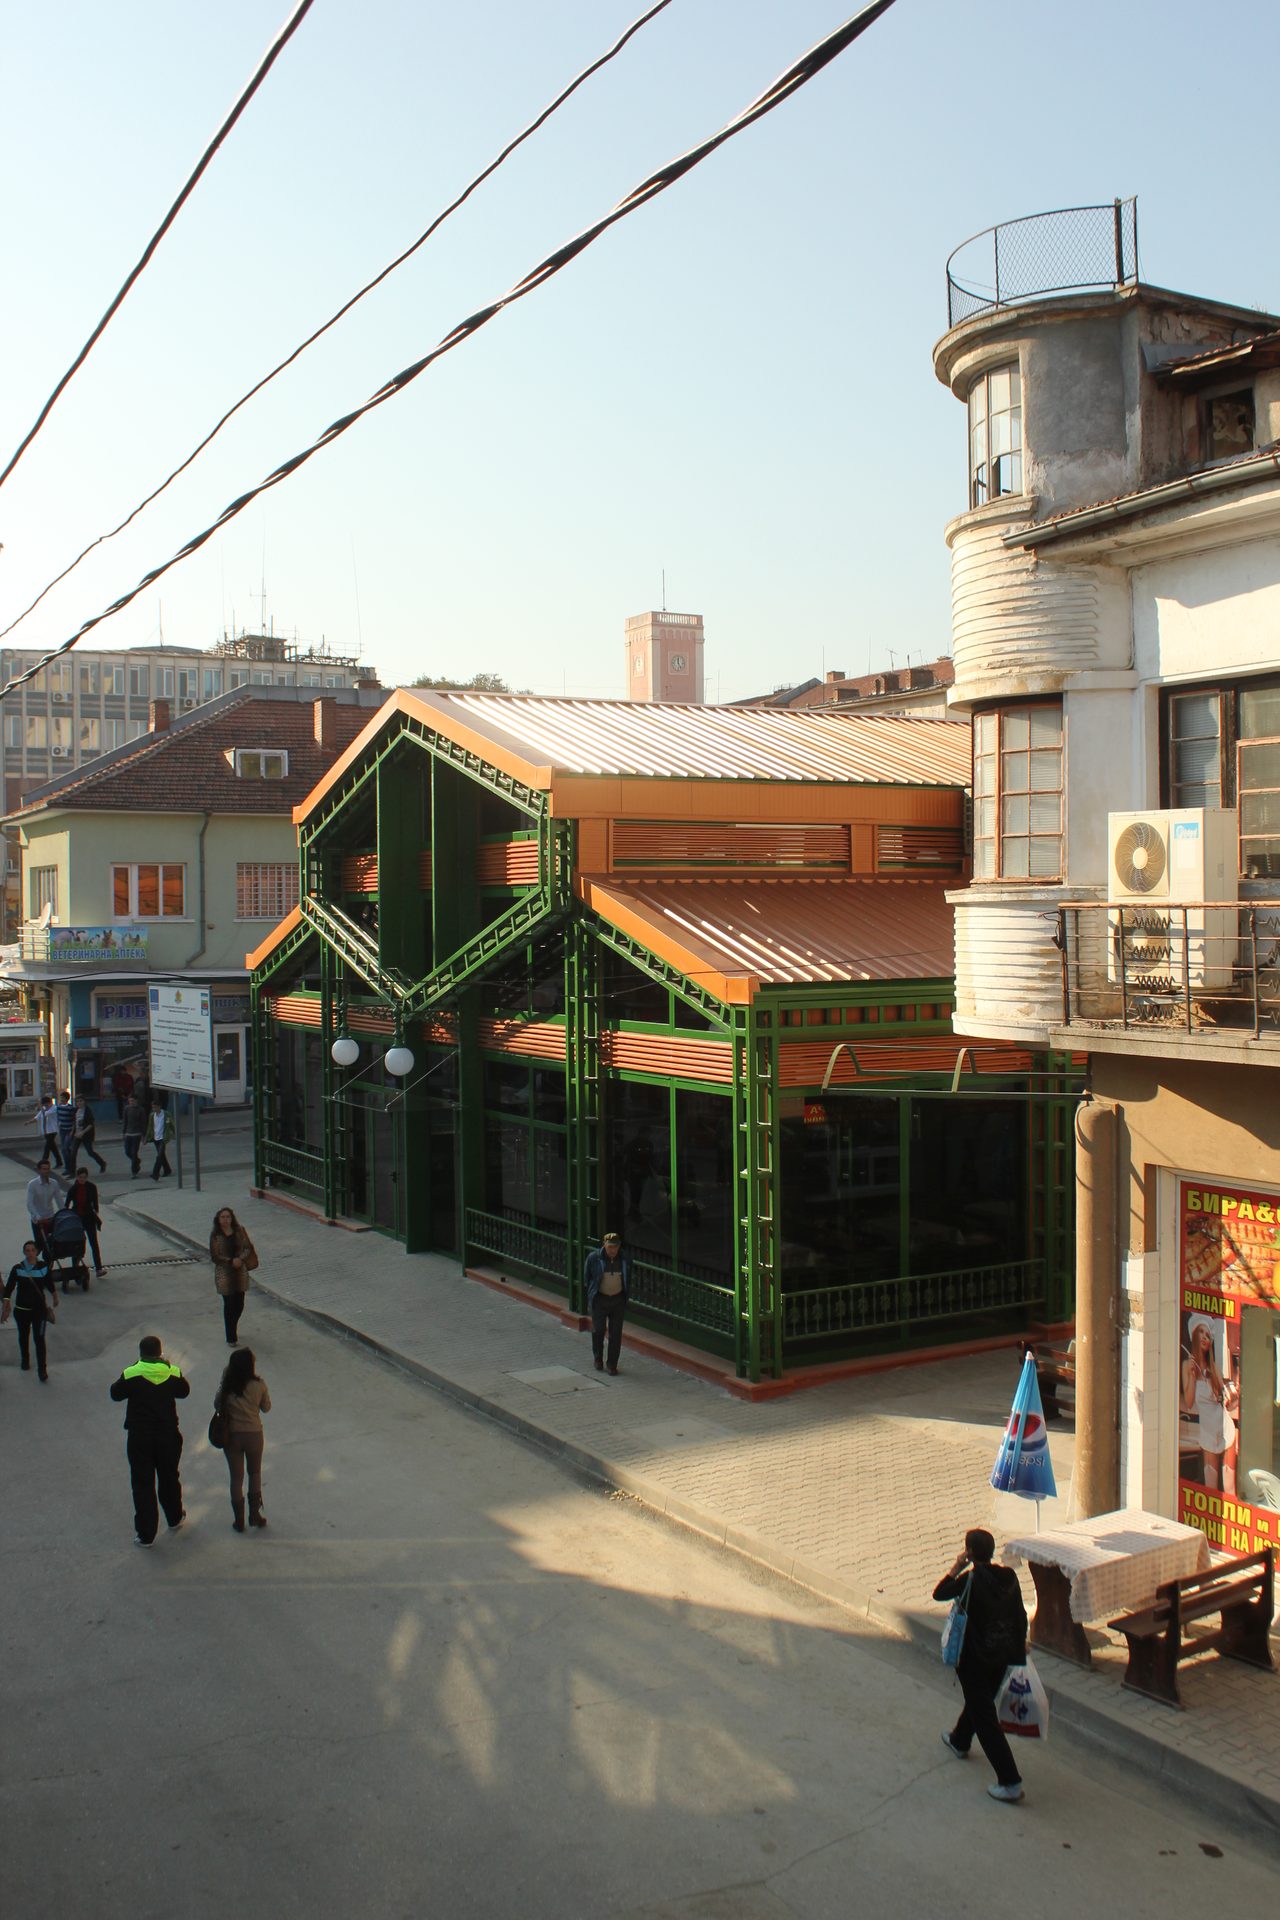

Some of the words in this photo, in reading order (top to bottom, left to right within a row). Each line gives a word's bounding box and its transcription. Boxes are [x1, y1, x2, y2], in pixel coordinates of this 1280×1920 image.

[53, 949, 112, 960] ВЕТЕРИНАРНА
[115, 948, 146, 960] АПТЕКА
[1187, 1190, 1280, 1224] БИРА&
[1184, 1290, 1235, 1318] ВИНАГИ
[1183, 1487, 1252, 1528] ТОПЛИ
[1231, 1528, 1250, 1553] НА
